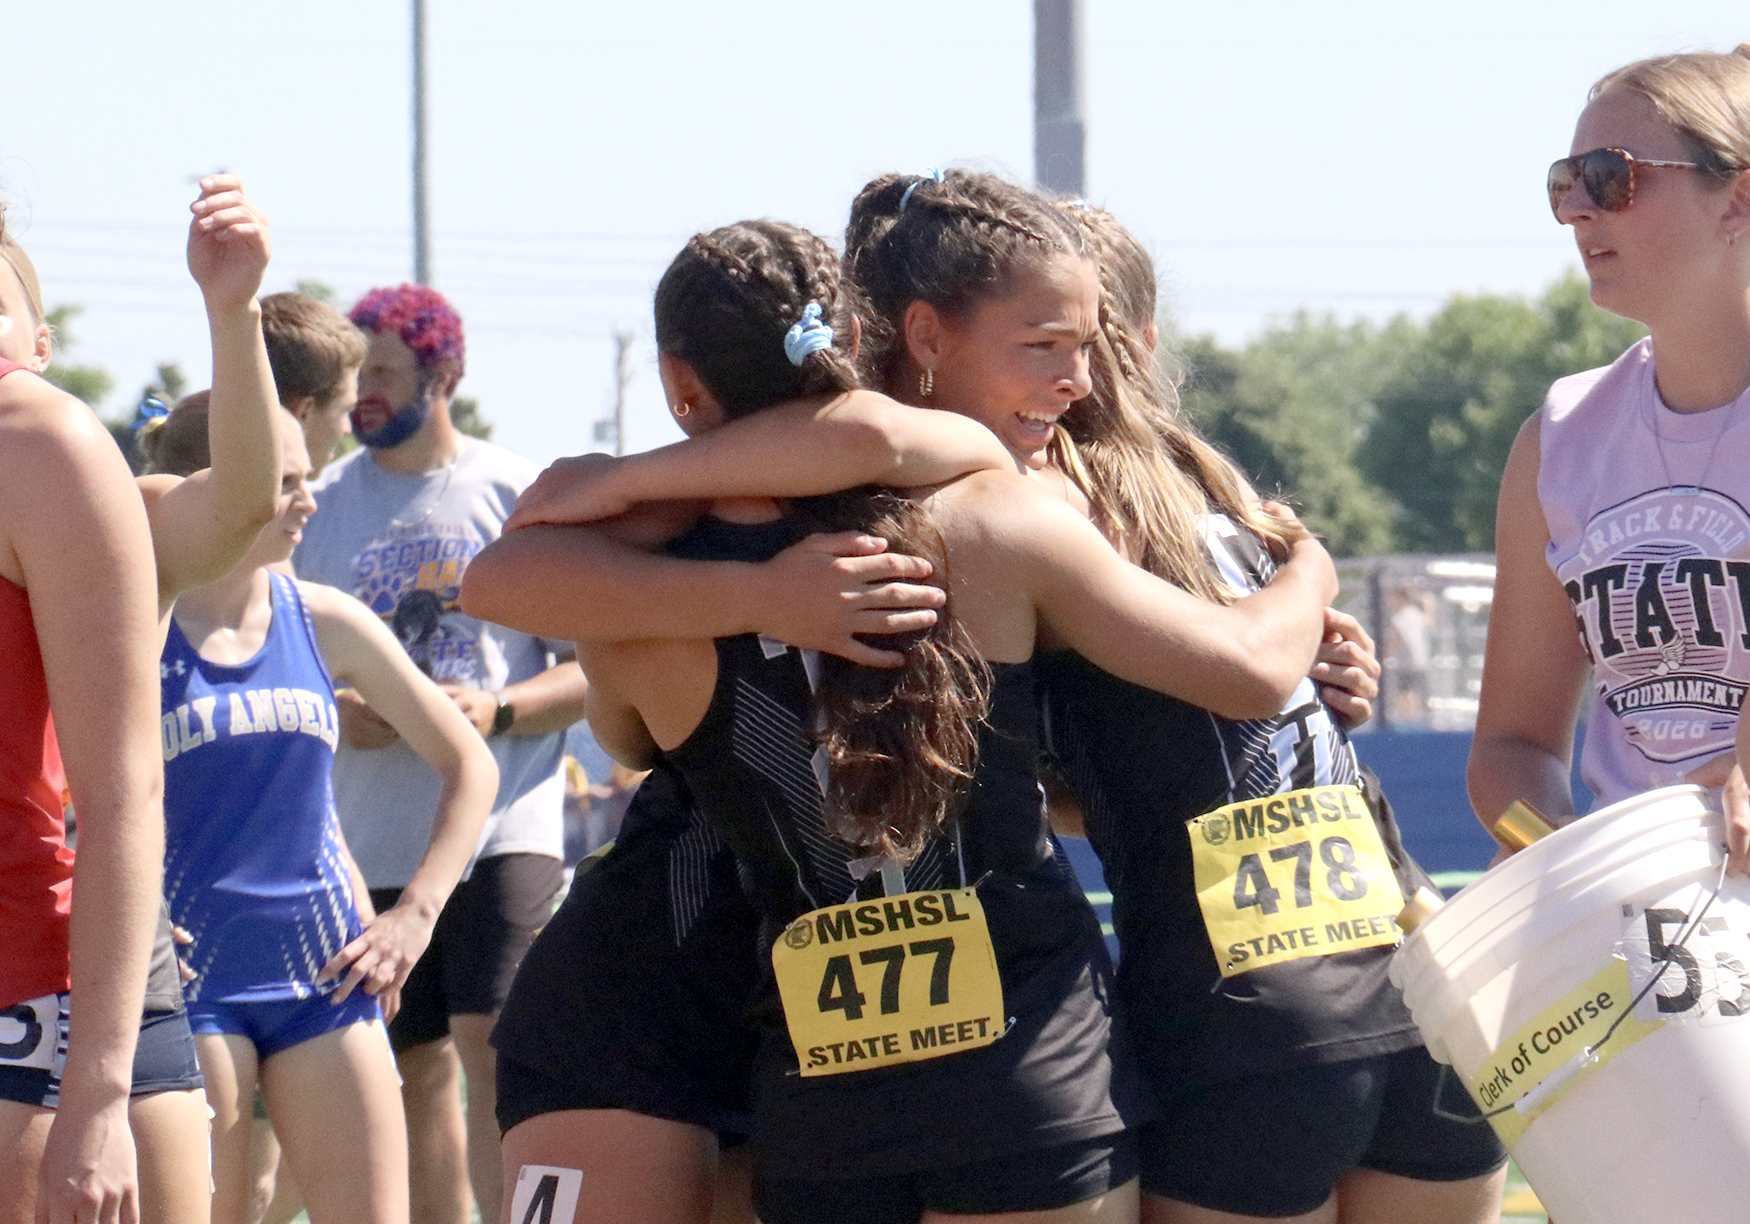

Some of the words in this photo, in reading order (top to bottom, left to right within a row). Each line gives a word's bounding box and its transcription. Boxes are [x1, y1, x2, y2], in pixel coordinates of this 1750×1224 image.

[1668, 504, 1684, 531] &
[1686, 505, 1745, 554] FIELD
[357, 538, 480, 578] SECTION
[1613, 679, 1744, 713] TOURNAMENT
[161, 695, 217, 762] OLY
[1232, 790, 1362, 842] MSHSL
[1232, 836, 1368, 916] 478
[815, 892, 970, 945] MSHSL
[1227, 926, 1318, 964] STATE
[1324, 914, 1398, 944] MEET
[816, 936, 956, 1022] 477
[807, 1032, 902, 1067] STATE
[909, 1016, 991, 1051] MEET
[1479, 1067, 1513, 1108] Clerk
[1511, 1043, 1532, 1075] of
[1531, 991, 1614, 1055] Course
